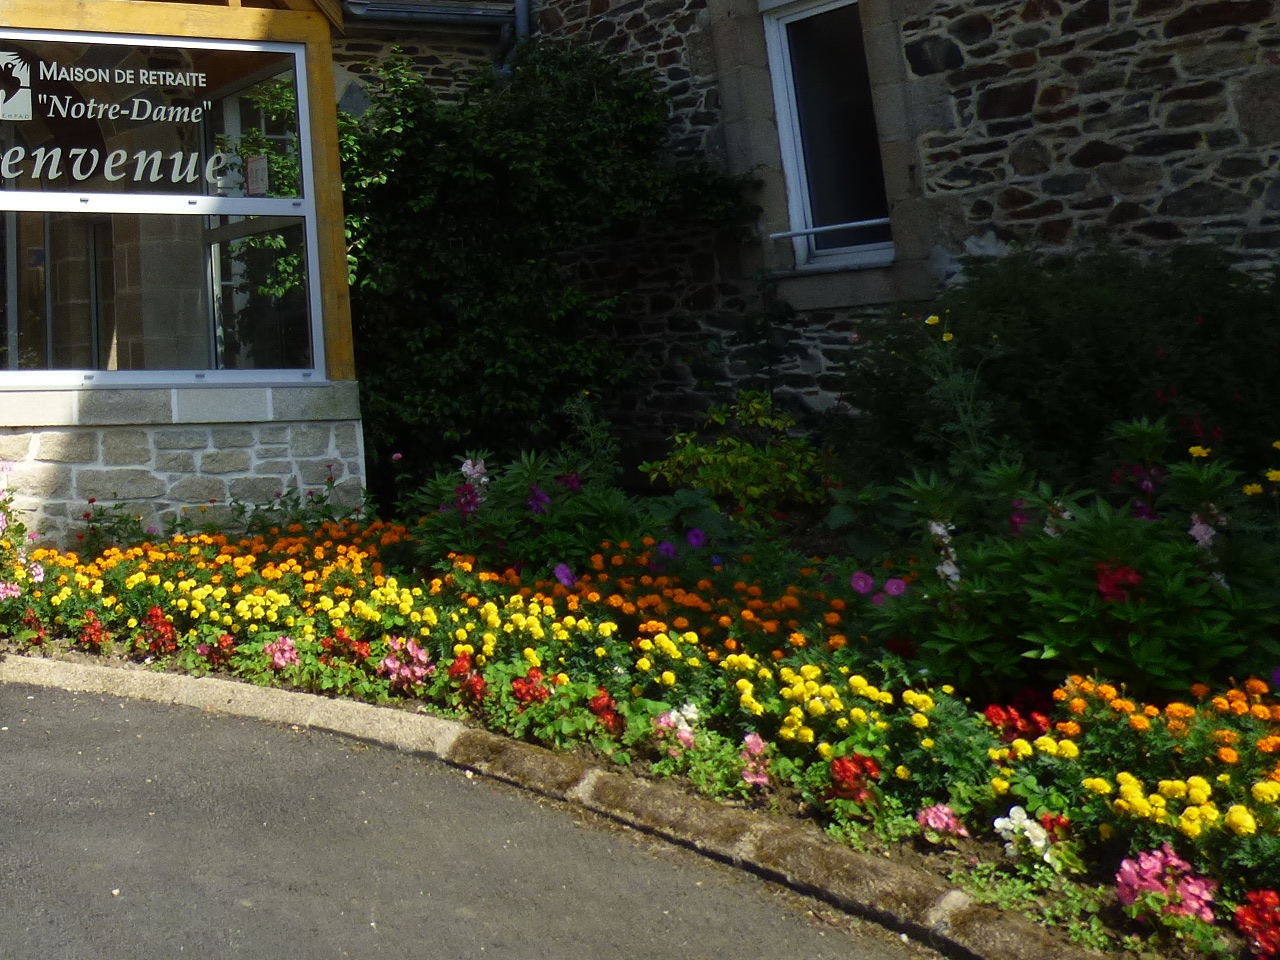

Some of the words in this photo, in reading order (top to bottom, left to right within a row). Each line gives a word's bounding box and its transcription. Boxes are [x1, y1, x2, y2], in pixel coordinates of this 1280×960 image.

[39, 61, 110, 83] MAISON
[114, 69, 135, 84] DE
[139, 69, 207, 87] RETRAITE
[37, 93, 212, 123] "Notre-Dame"
